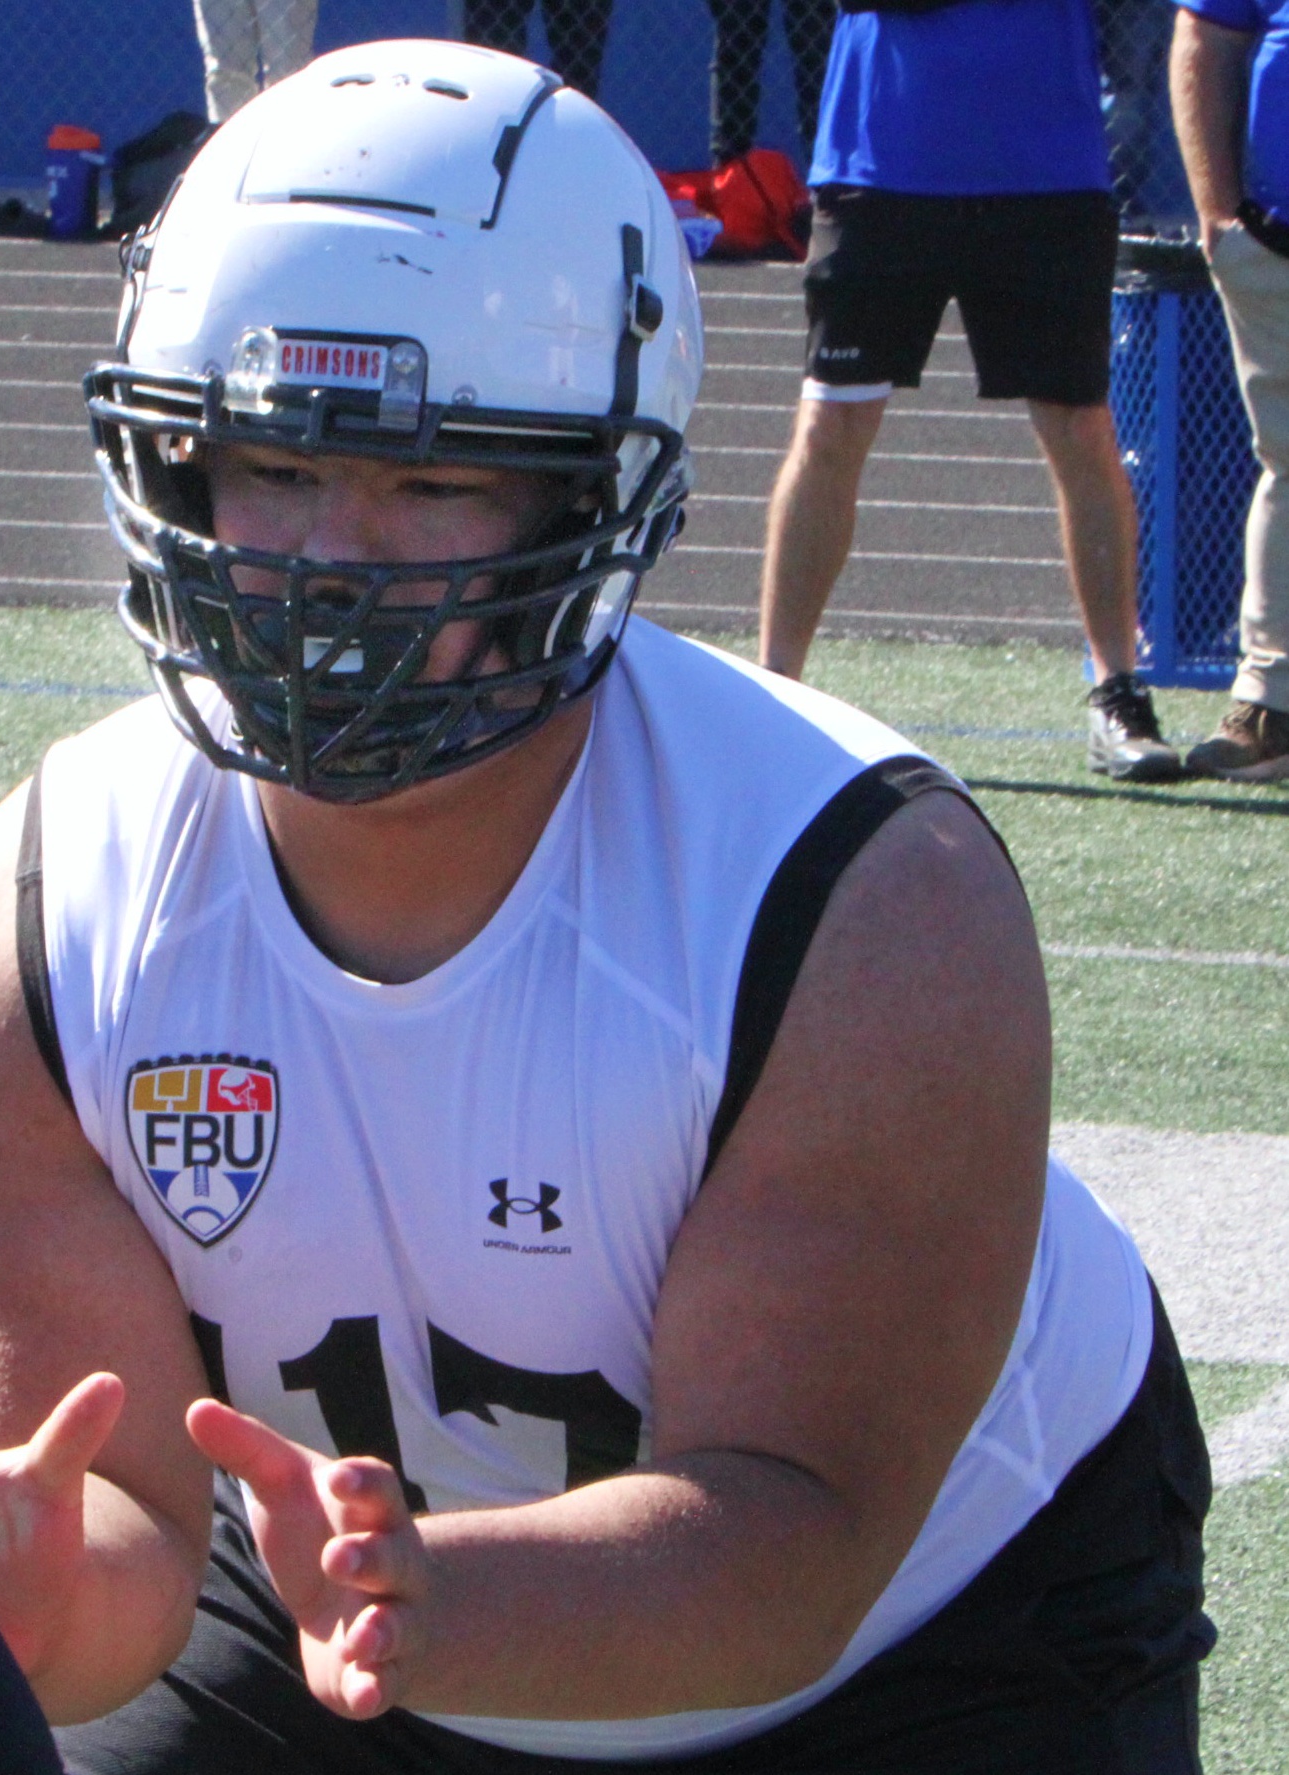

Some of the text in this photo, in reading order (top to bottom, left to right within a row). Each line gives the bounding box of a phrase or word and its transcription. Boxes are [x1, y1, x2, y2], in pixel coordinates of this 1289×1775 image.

[281, 344, 382, 380] CRIMSONS
[145, 1112, 265, 1170] FBU
[482, 1239, 572, 1256] UNDER ARMOUR
